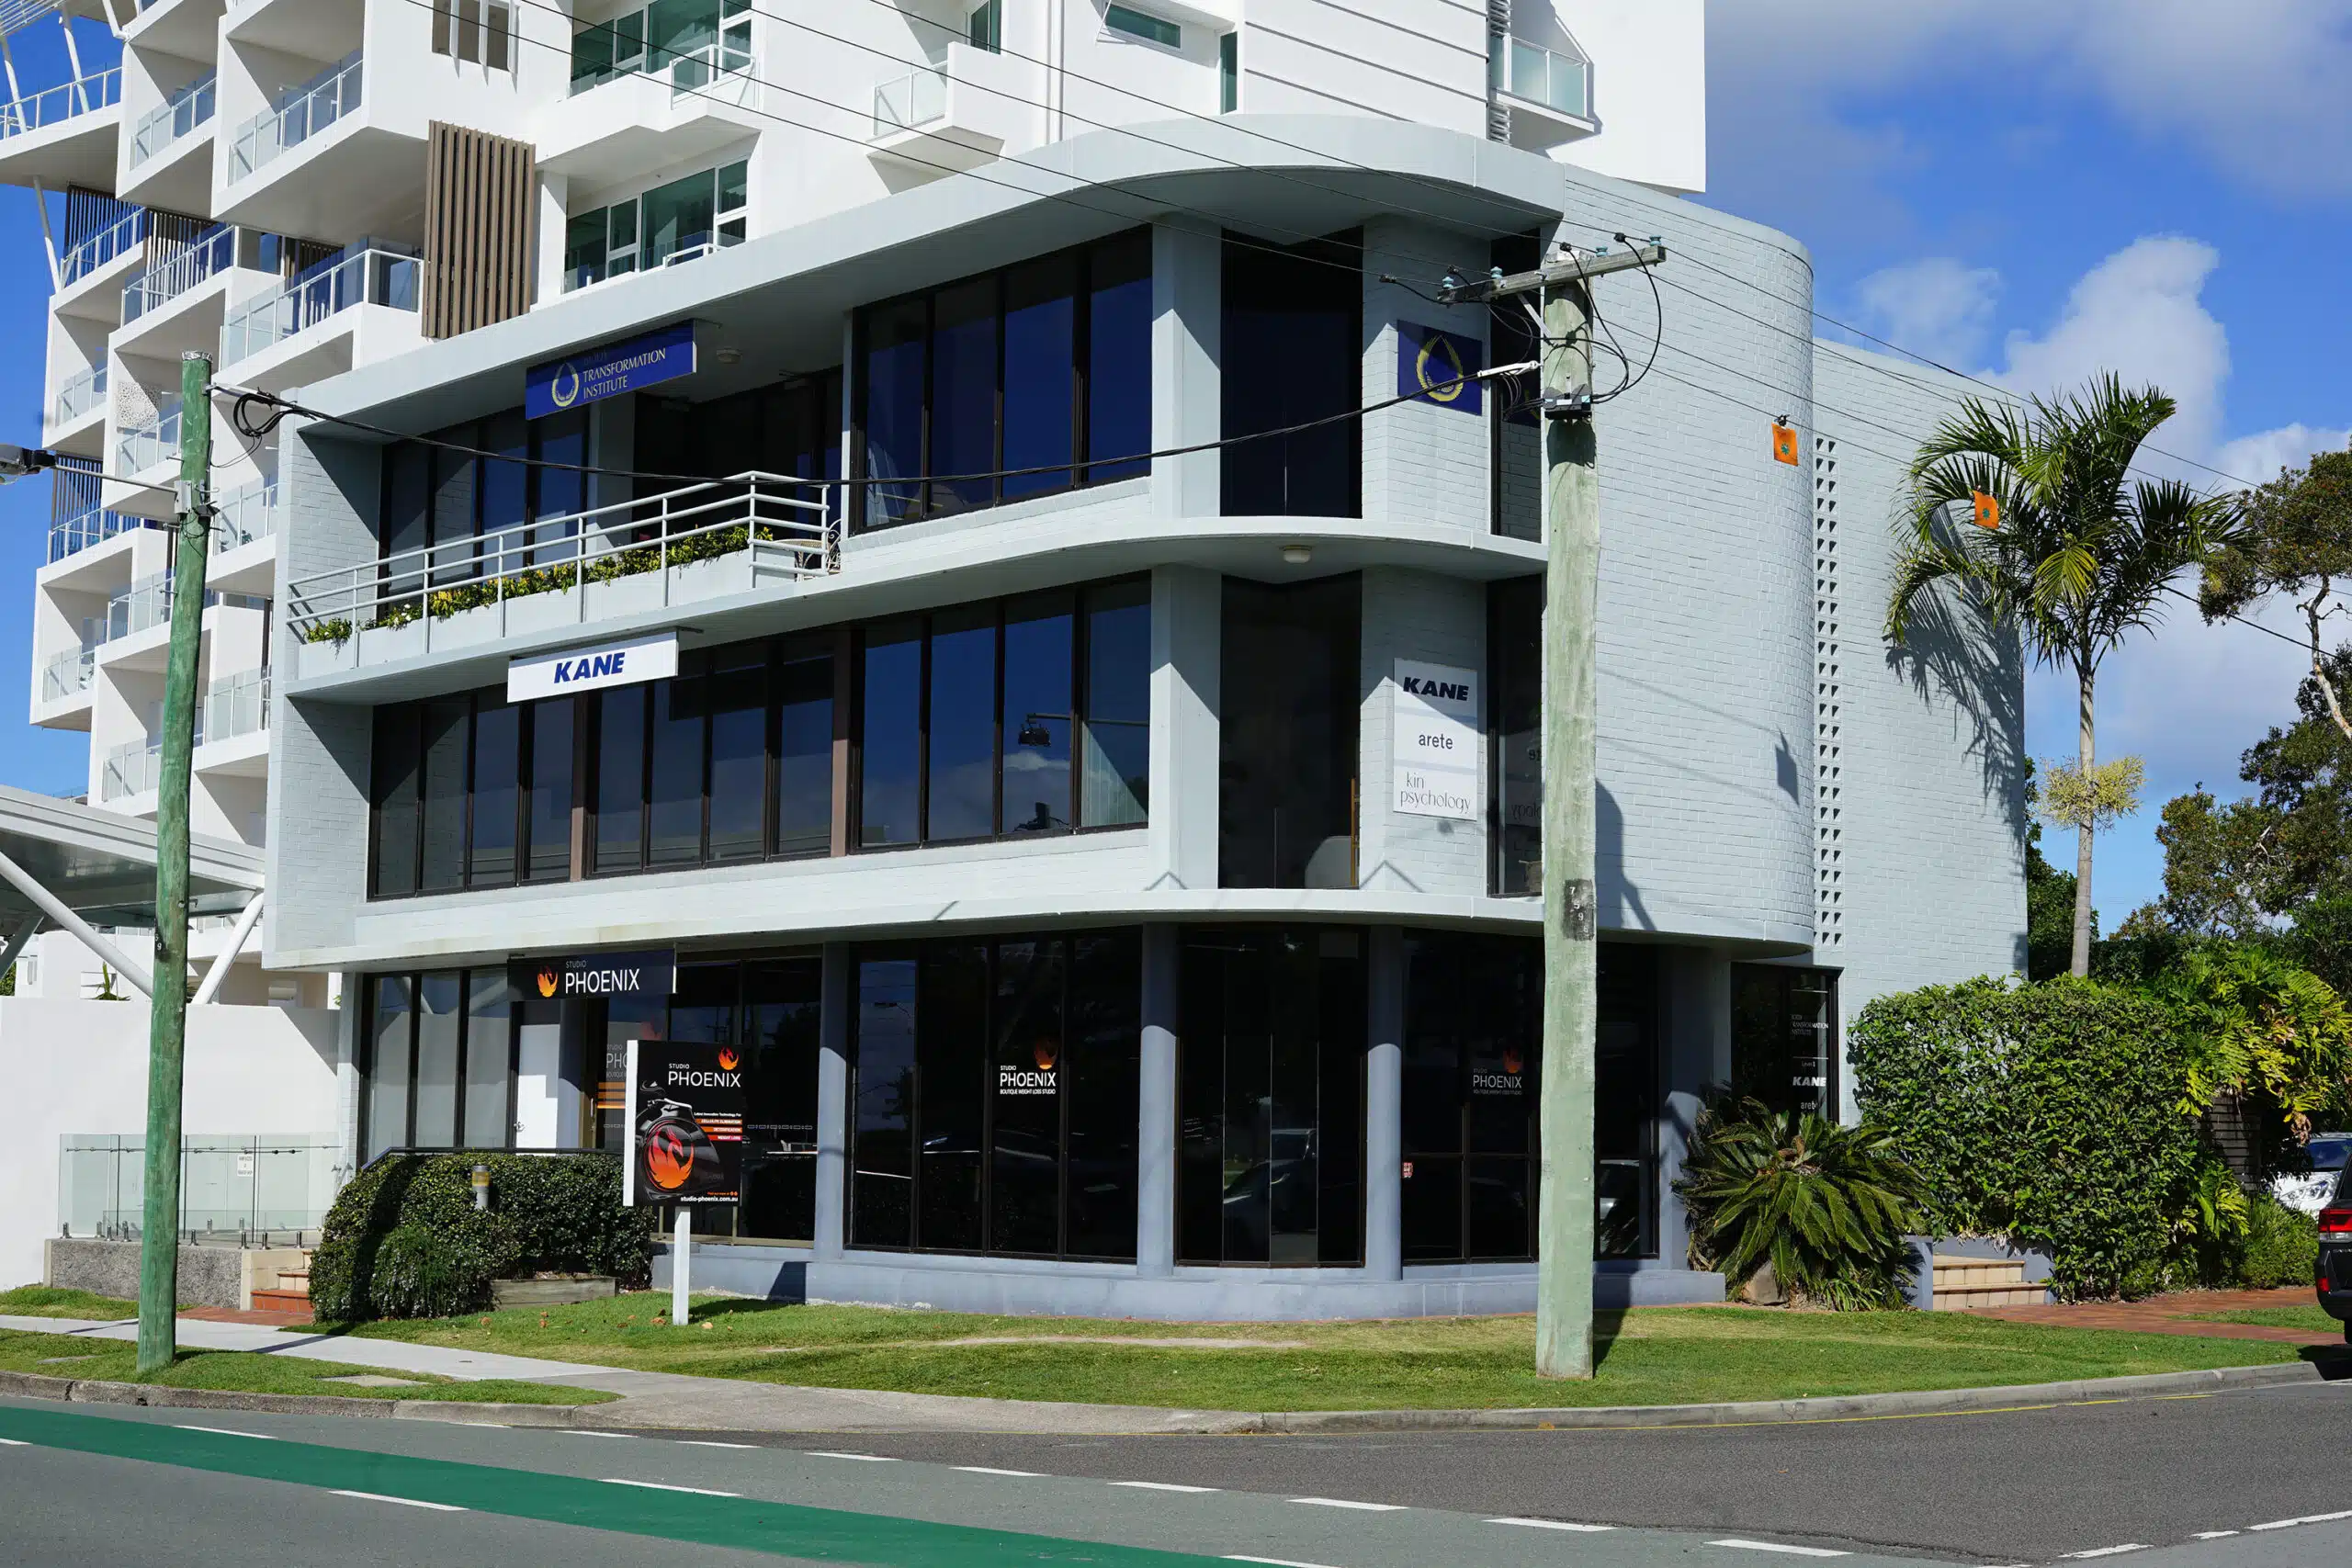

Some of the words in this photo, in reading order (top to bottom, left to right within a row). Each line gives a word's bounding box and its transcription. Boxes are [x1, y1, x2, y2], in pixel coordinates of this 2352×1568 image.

[583, 347, 666, 382] TRANSFORMATION
[583, 375, 628, 400] INSTITUTE
[554, 652, 626, 683] KANE
[1403, 677, 1470, 701] KANE
[1419, 733, 1453, 750] arete
[1407, 772, 1424, 788] kin
[1400, 790, 1471, 814] psychology
[565, 960, 587, 969] STUDIO
[565, 968, 640, 994] PHOENIX
[668, 1071, 741, 1088] PHOENIX
[1000, 1072, 1057, 1087] PHOENIX
[1473, 1075, 1522, 1089] PHOENIX
[1792, 1077, 1827, 1087] KANE
